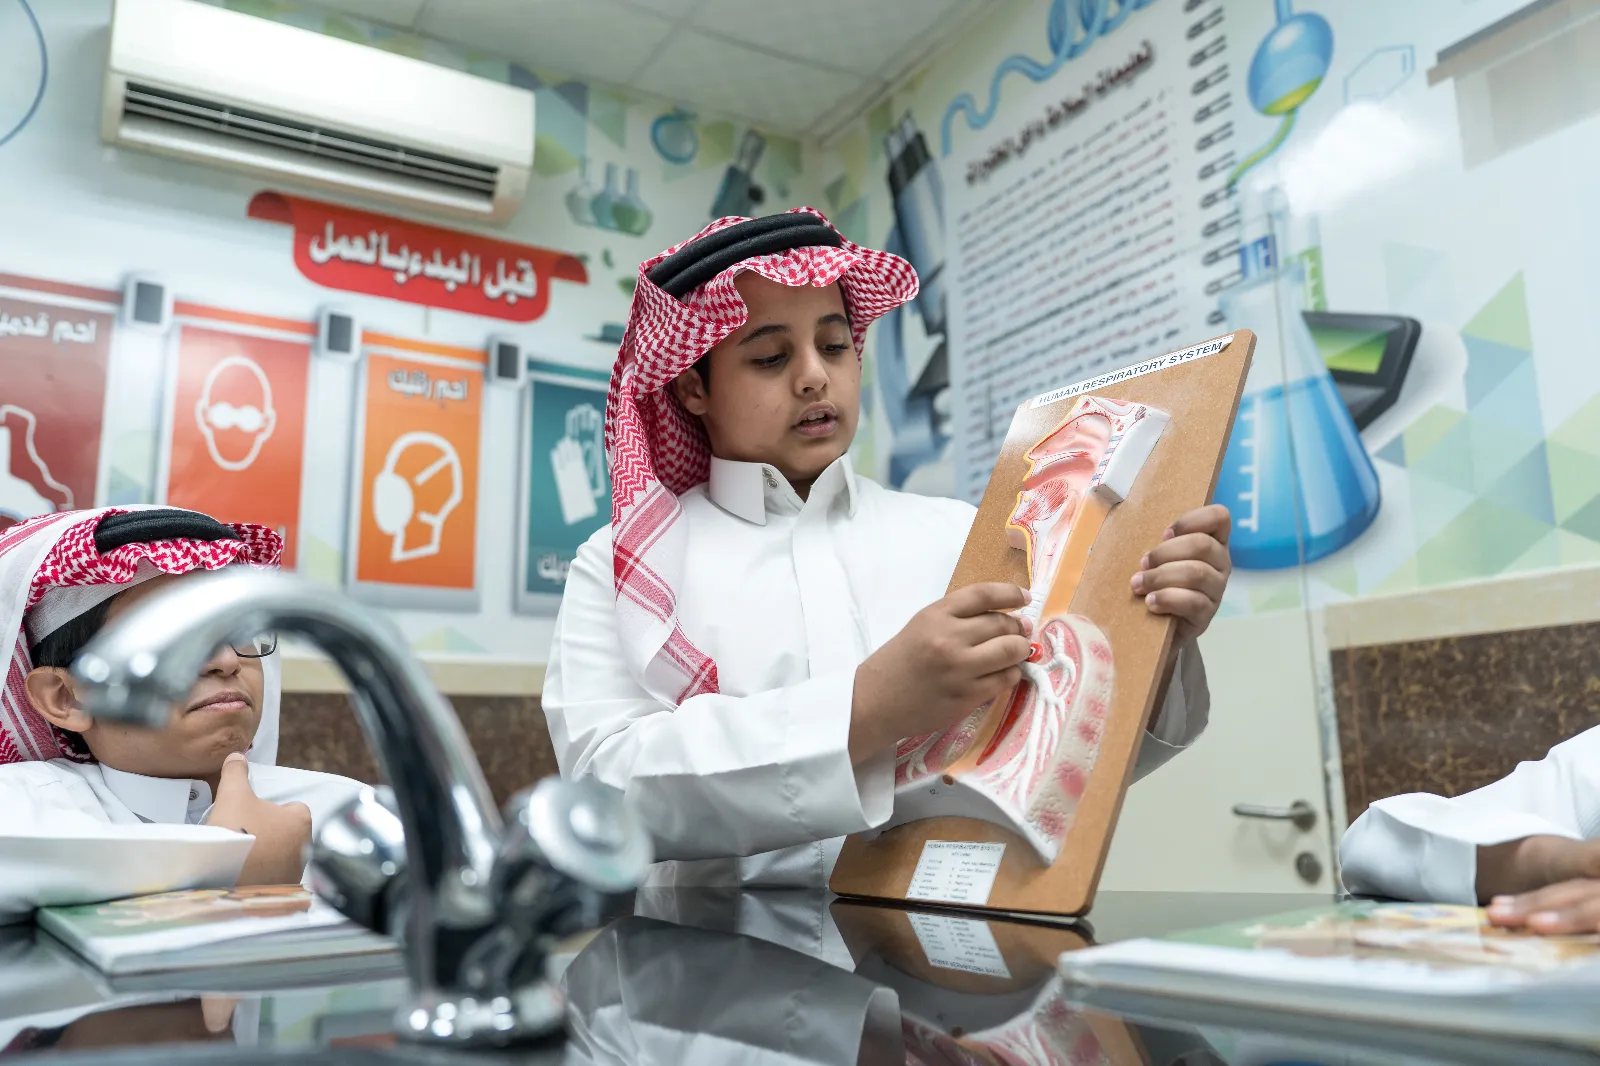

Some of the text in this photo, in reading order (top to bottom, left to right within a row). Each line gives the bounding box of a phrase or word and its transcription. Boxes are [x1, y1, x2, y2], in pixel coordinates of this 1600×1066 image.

[483, 258, 538, 305] قبل
[0, 309, 50, 337] قدمي
[1038, 340, 1223, 405] HUMAN RESPIRATORY SYSTEM
